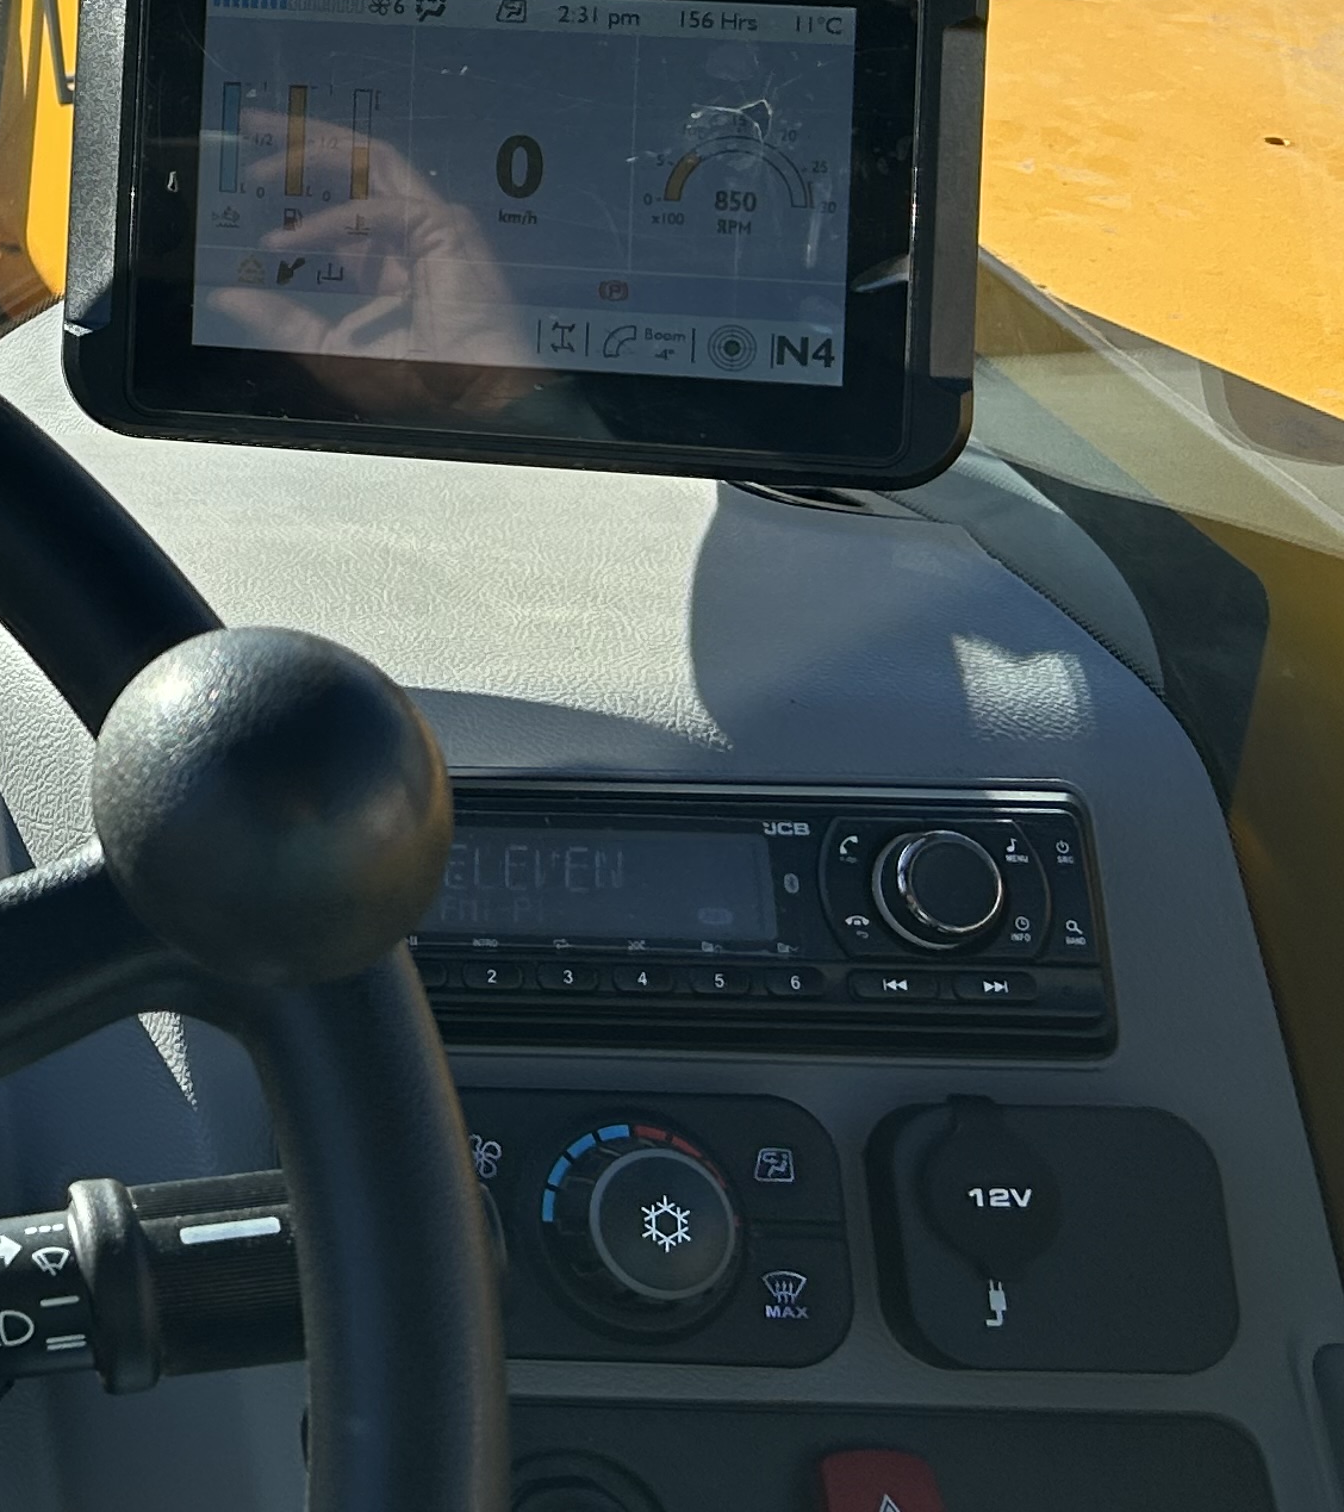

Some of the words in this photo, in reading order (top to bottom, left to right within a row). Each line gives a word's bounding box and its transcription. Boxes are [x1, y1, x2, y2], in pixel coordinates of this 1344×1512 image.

[557, 5, 598, 24] 2:31
[608, 13, 641, 30] pm
[679, 10, 714, 28] 156
[720, 12, 758, 31] Hrs
[794, 15, 842, 35] 11°C
[496, 134, 544, 199] 0
[714, 190, 757, 213] 850
[498, 209, 538, 225] km/h
[651, 212, 685, 226] x100
[716, 218, 752, 236] RPM
[644, 327, 687, 343] Boom
[776, 335, 836, 369] N4
[764, 821, 810, 837] JCB
[487, 970, 497, 985] 2
[563, 970, 574, 985] 3
[637, 971, 648, 986] 4
[714, 974, 725, 989] 5
[790, 975, 801, 990] 6
[967, 1187, 1033, 1209] 12V
[764, 1303, 809, 1320] MAX
